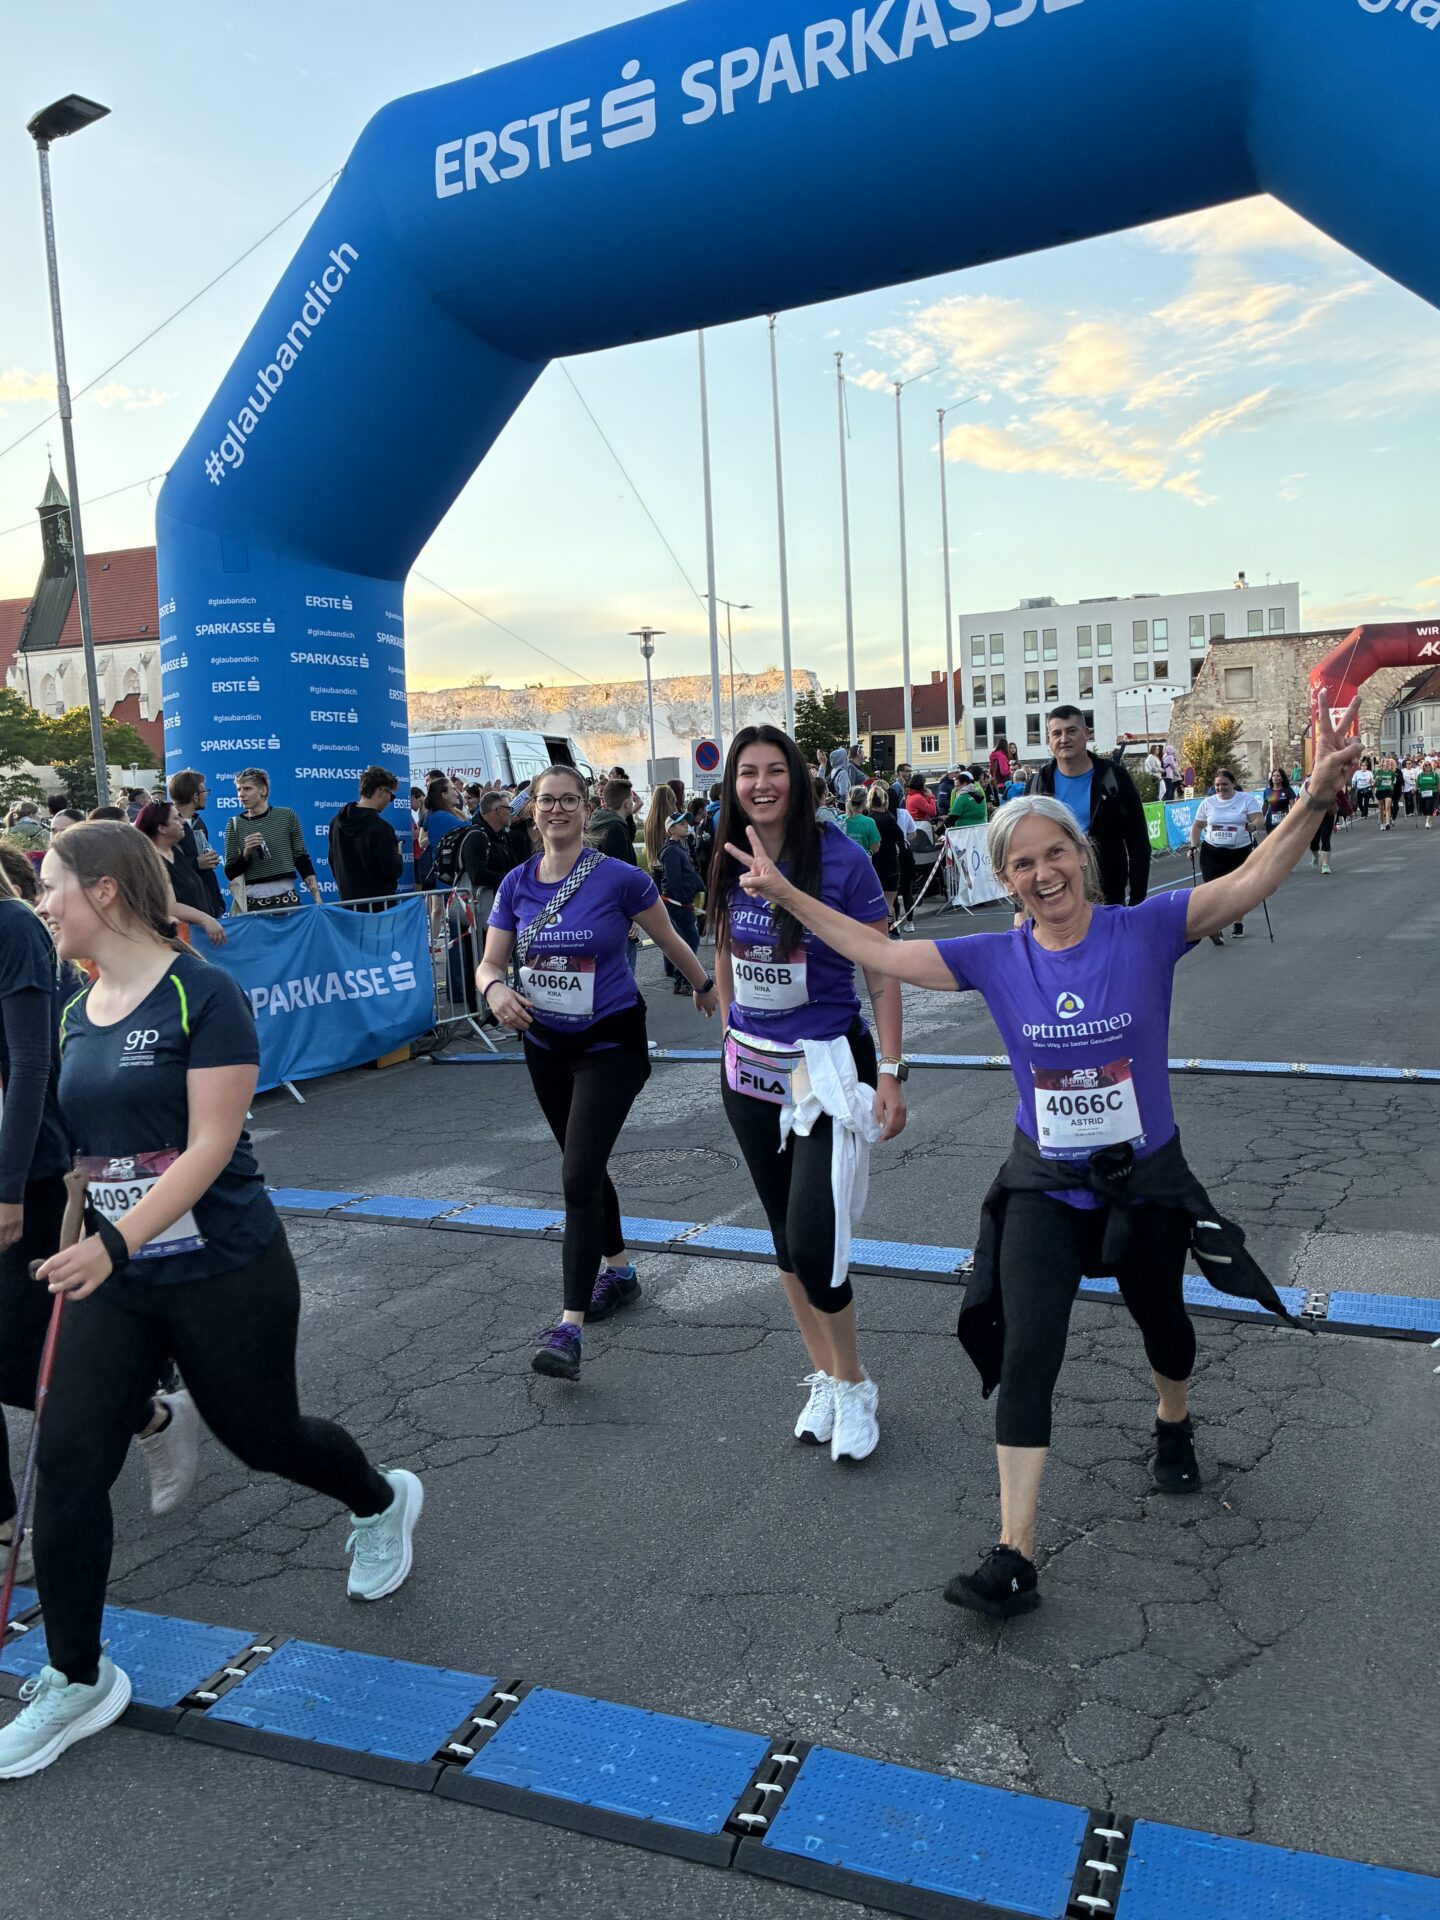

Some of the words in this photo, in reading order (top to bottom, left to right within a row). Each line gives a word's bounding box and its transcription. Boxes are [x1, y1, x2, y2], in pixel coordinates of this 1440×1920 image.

[435, 98, 592, 199] ERSTE
[680, 0, 1085, 125] SPARKAS
[204, 242, 360, 486] #glaubandich
[208, 597, 256, 606] #glaubandich
[305, 595, 341, 610] ERSTE
[195, 621, 261, 636] SPARKASSE
[307, 628, 355, 639] #glaubandich
[1416, 626, 1439, 636] WIR
[210, 655, 259, 664] #glaubandich
[290, 652, 358, 668] SPARKASSE
[211, 681, 246, 693] ERSTE
[309, 686, 357, 696] #glaubandich
[213, 713, 261, 723] #glaubandich
[310, 710, 346, 723] ERSTE
[200, 739, 266, 752] SPARKASSE
[312, 743, 359, 752] #glaubandich
[295, 767, 361, 780] SPARKASSE
[446, 766, 481, 777] timing
[217, 797, 244, 809] ERST
[753, 945, 773, 955] 25
[550, 956, 568, 965] 25
[735, 963, 792, 985] 4066B
[528, 974, 582, 991] 4066A
[243, 967, 390, 1019] PARKASSE
[754, 985, 771, 993] NINA
[1047, 1041, 1061, 1049] Weg
[1070, 1039, 1089, 1048] bester
[1090, 1033, 1123, 1046] Gesundheit
[1071, 1068, 1098, 1080] 25
[740, 1070, 786, 1095] FILA
[1046, 1090, 1123, 1116] 4066C
[1070, 1117, 1104, 1127] ASTRID
[108, 1158, 135, 1169] 25
[94, 1183, 155, 1211] 4093
